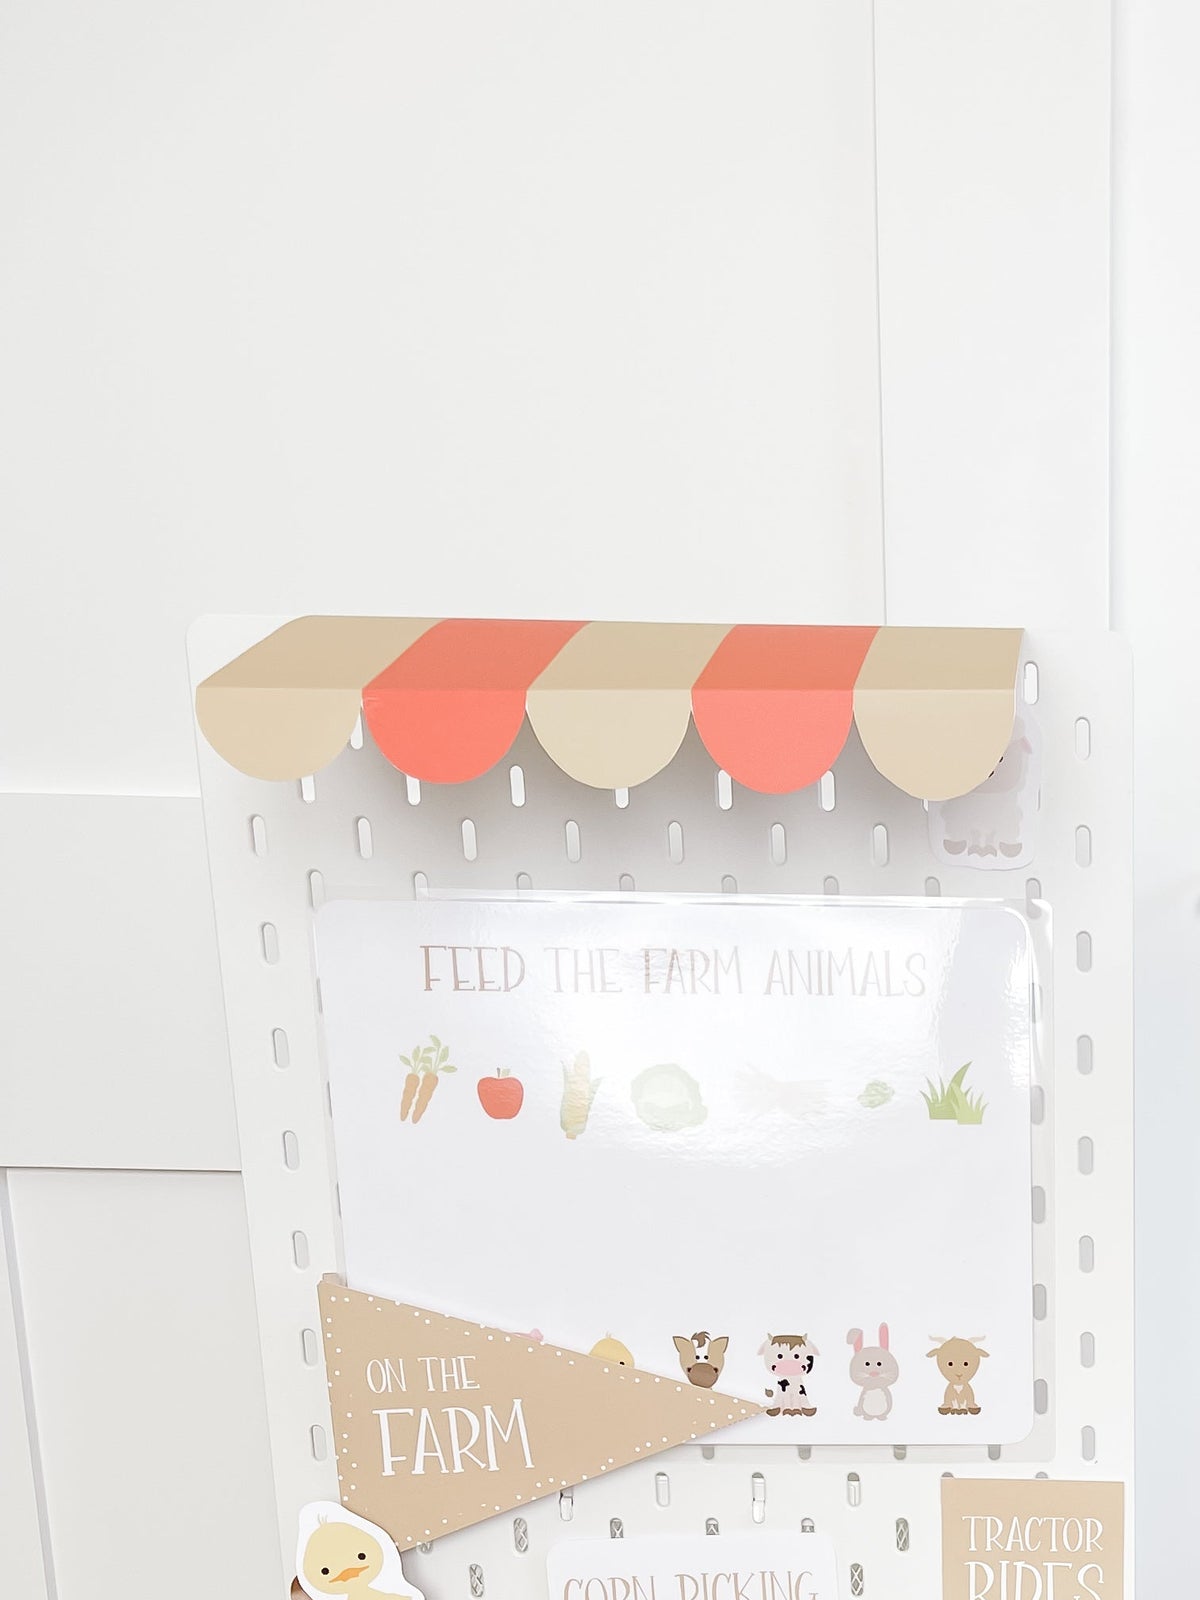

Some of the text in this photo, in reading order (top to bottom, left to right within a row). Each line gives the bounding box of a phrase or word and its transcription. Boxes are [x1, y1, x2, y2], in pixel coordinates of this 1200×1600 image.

[419, 945, 927, 997] FEED THE FARM ANIMALS
[366, 1355, 480, 1393] ON THE
[372, 1398, 535, 1476] FARM
[962, 1515, 1104, 1552] TRACTOR
